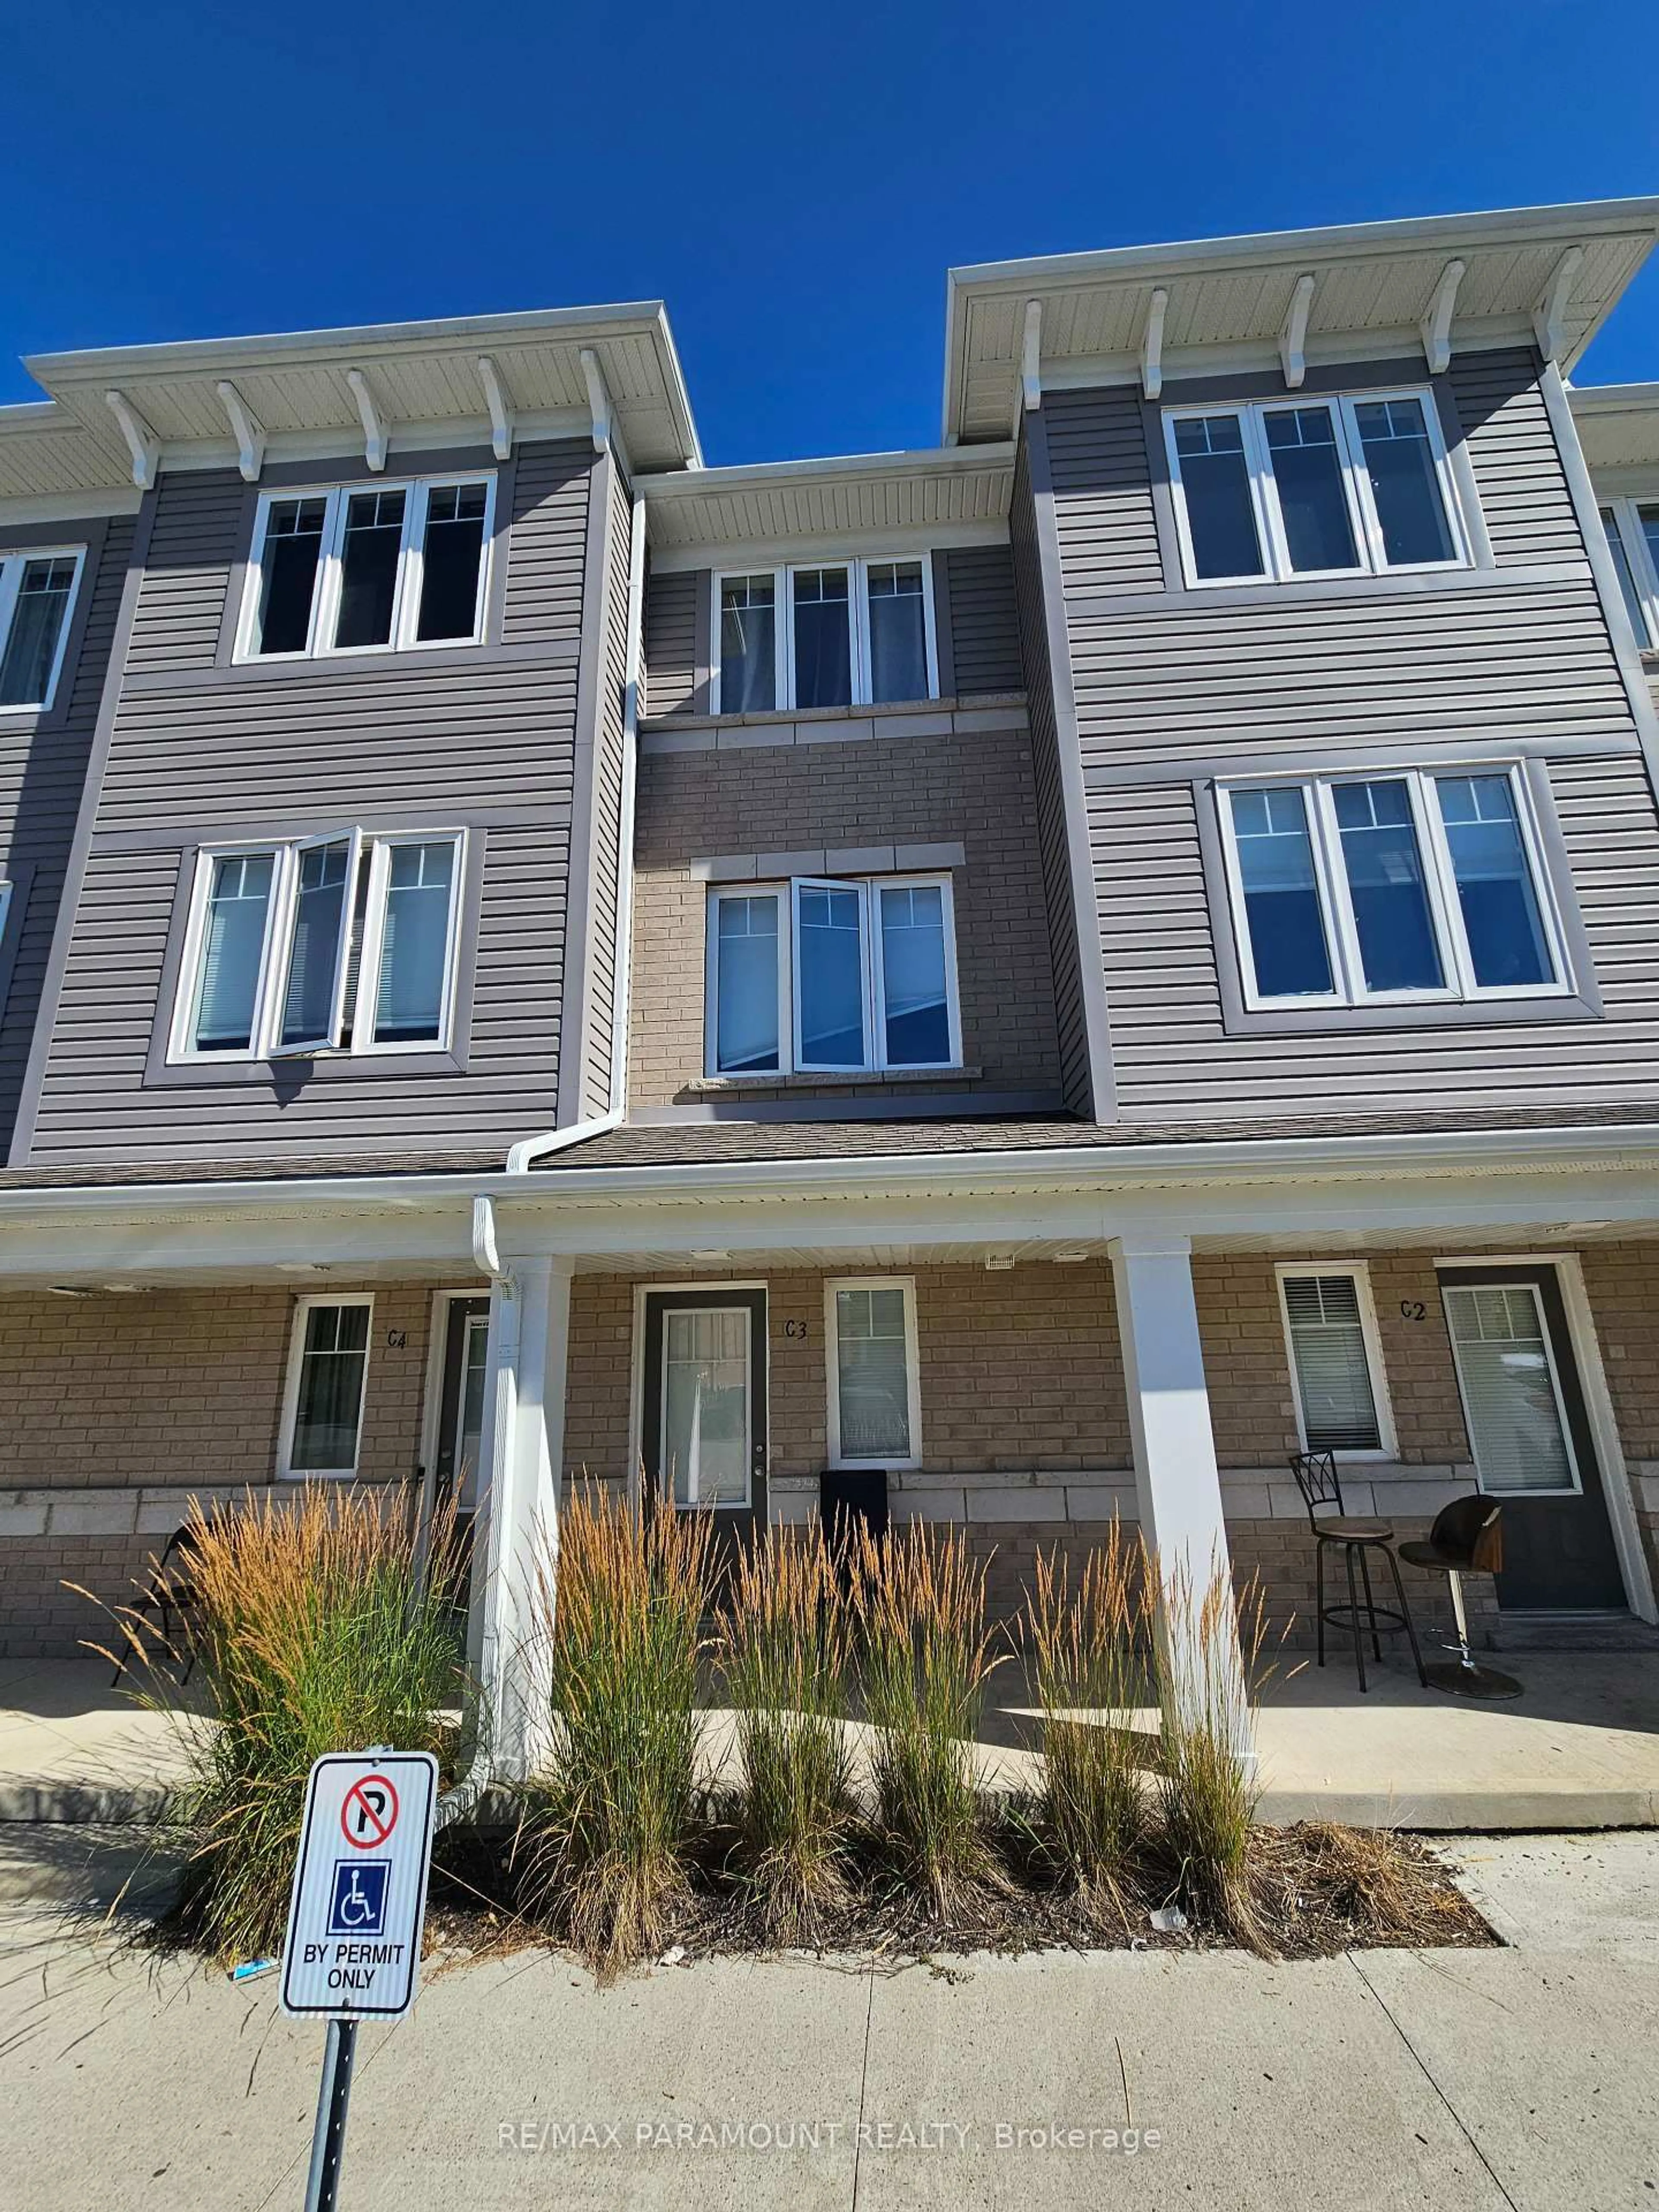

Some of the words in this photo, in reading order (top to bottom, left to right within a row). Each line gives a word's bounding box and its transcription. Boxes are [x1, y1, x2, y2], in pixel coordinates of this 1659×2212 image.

[1401, 1300, 1425, 1321] C2
[786, 1319, 807, 1339] C3
[388, 1329, 406, 1350] C4
[357, 1791, 386, 1832] P
[304, 1944, 329, 1964] BY
[335, 1944, 405, 1964] PERMIT
[327, 1969, 375, 1989] ONLY
